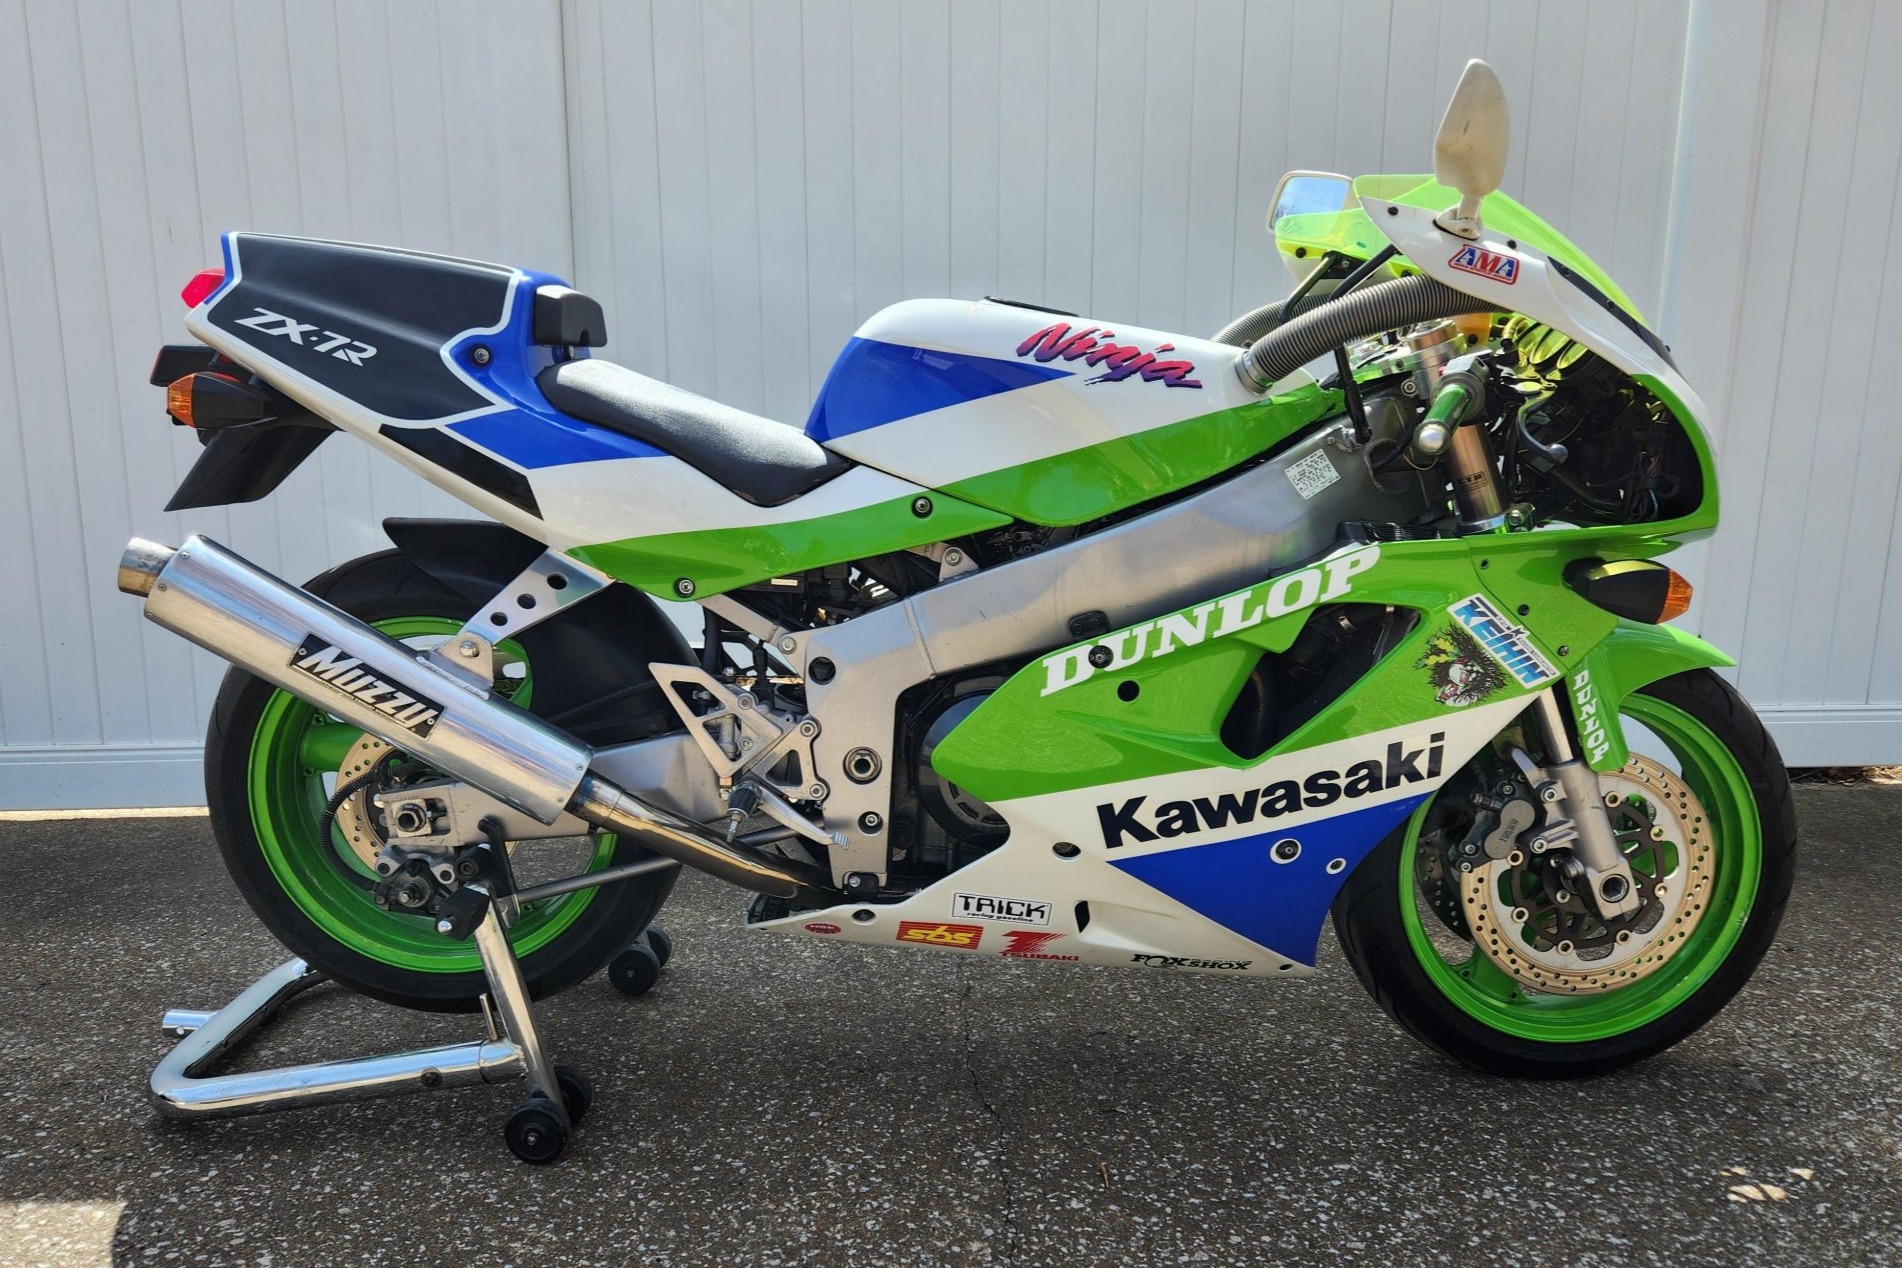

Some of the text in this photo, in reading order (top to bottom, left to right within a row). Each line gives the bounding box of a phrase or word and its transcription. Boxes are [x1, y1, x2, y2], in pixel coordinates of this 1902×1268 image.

[1455, 248, 1515, 277] AMA
[1016, 322, 1203, 389] Ninja
[1040, 545, 1381, 697] DUNLOP
[1454, 599, 1550, 684] KEIHIN
[1573, 670, 1610, 764] DUNLOP
[1096, 731, 1446, 849] Kawasaki
[958, 895, 1046, 919] TRICK
[967, 911, 1034, 923] racing gasoline
[903, 925, 975, 945] sbs
[1000, 951, 1079, 961] TSUBAKI
